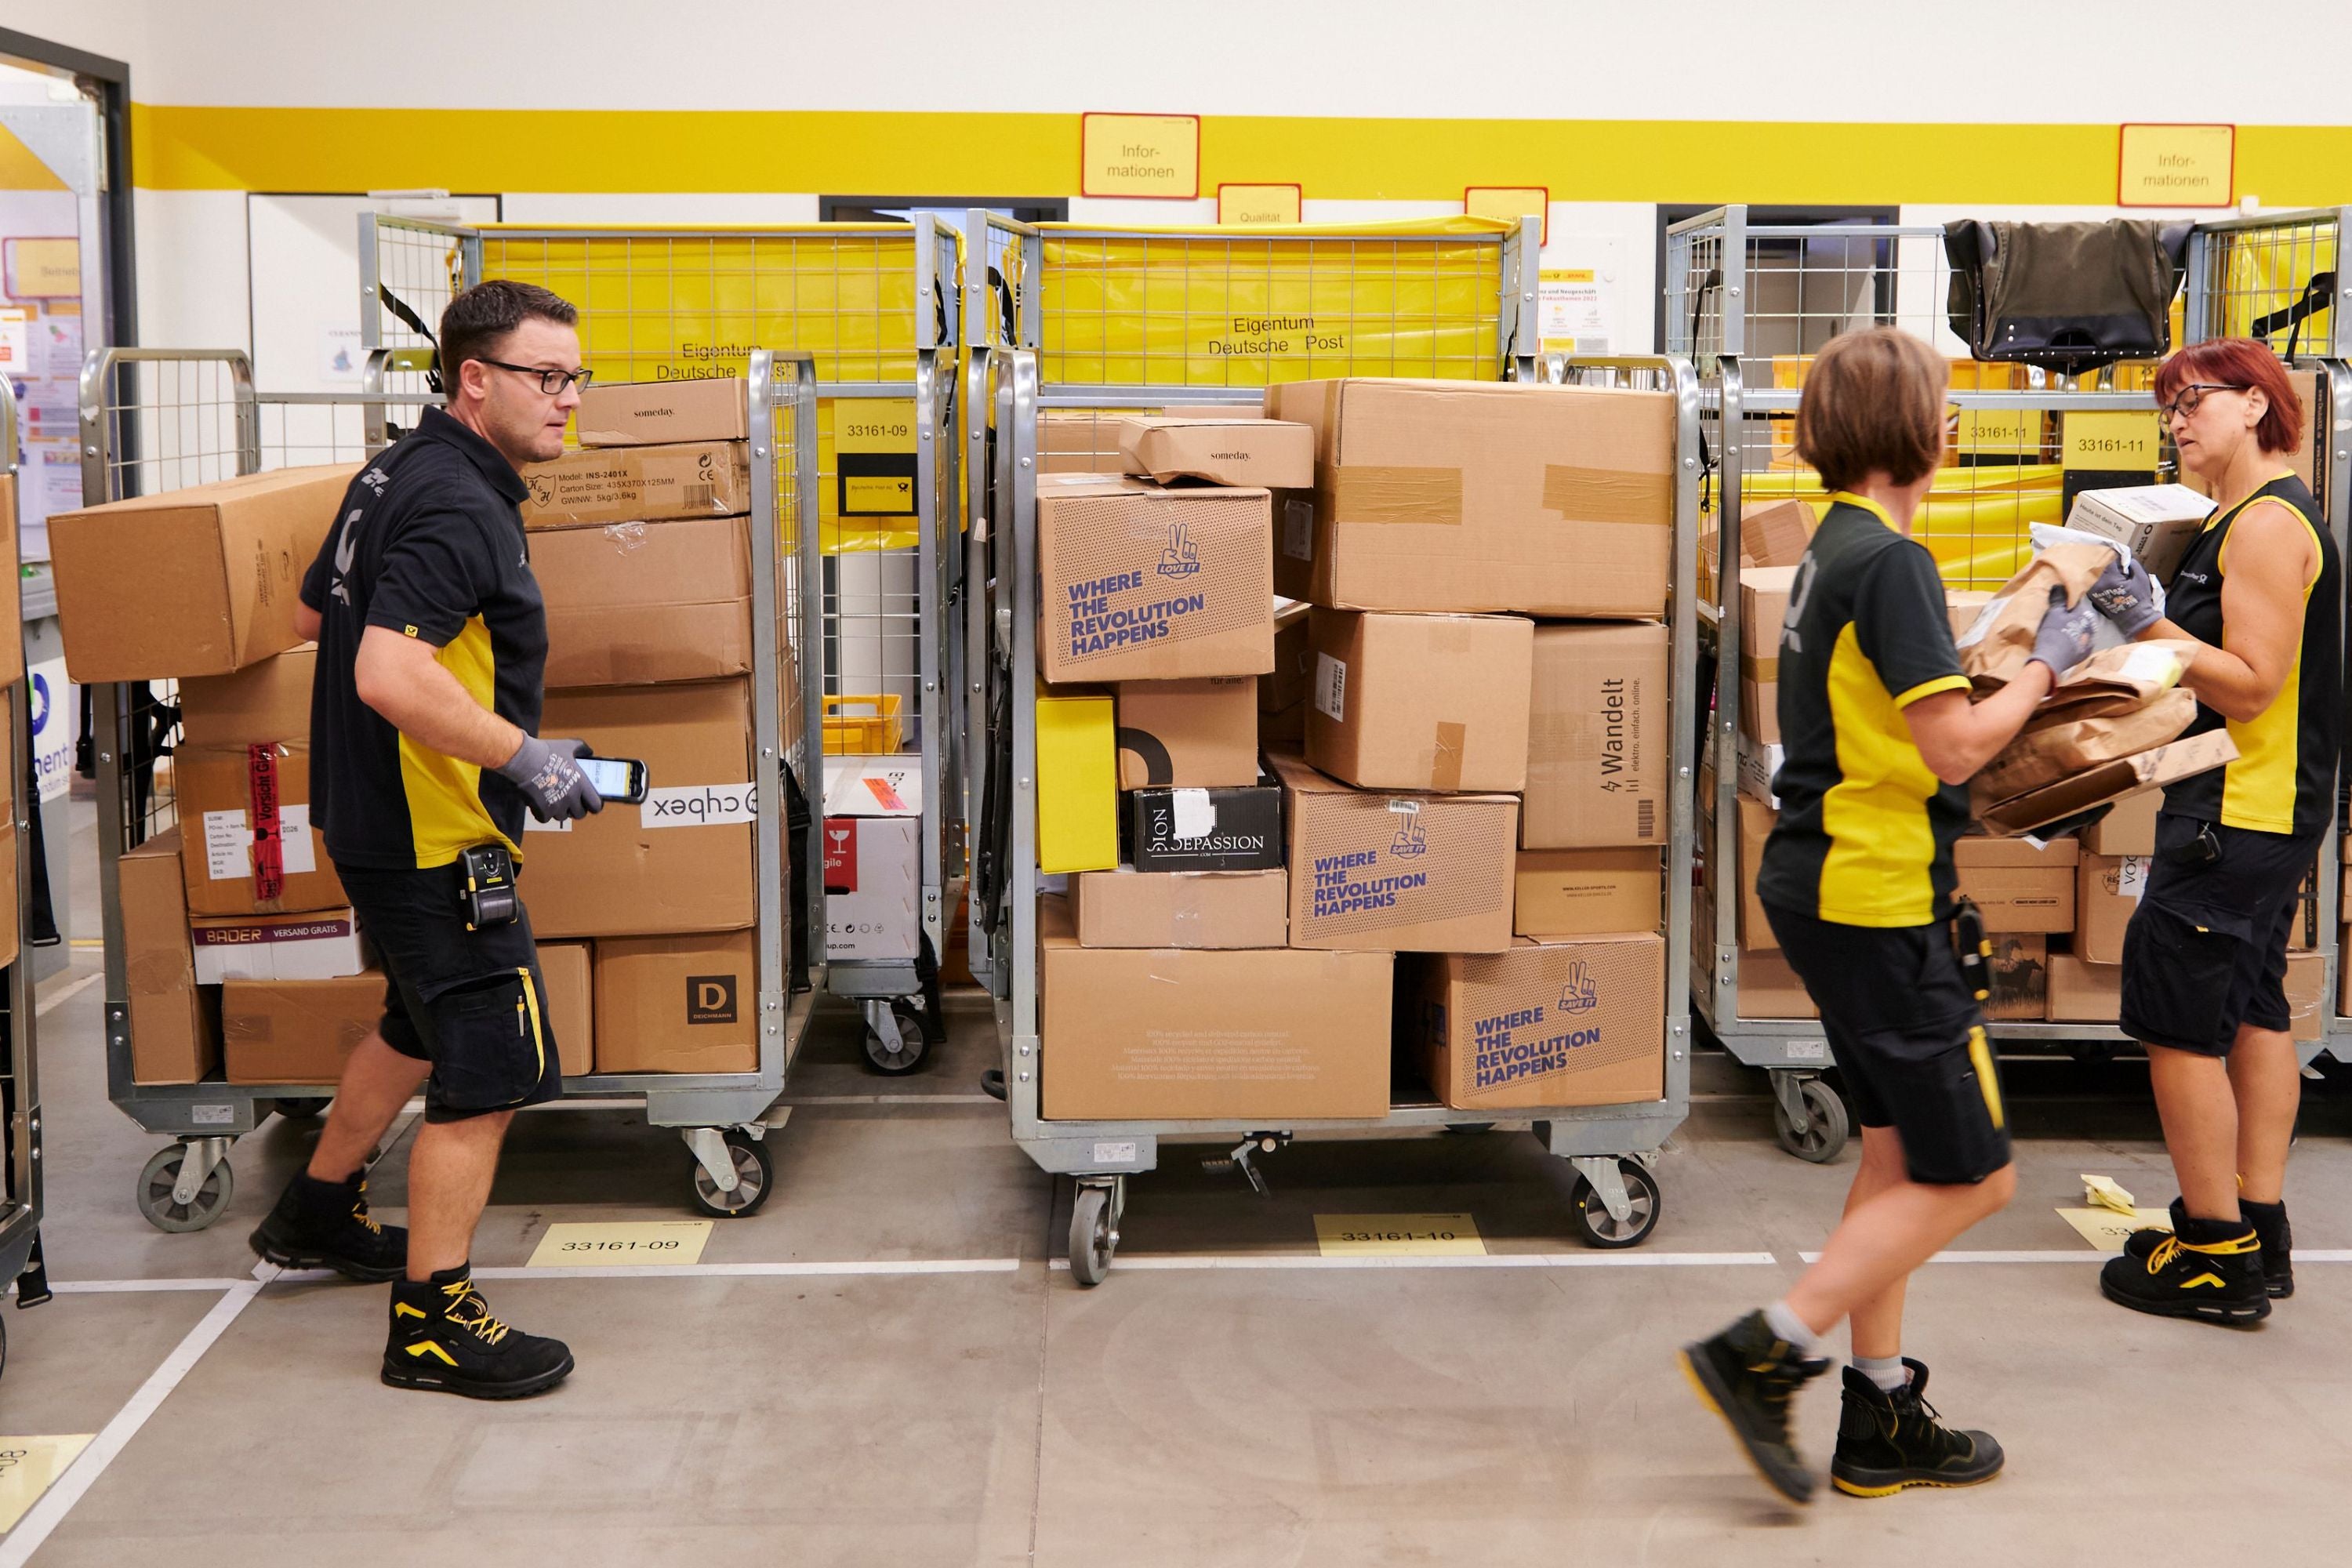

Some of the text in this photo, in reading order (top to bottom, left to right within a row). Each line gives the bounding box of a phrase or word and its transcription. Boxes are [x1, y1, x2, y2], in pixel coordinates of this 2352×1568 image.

[1122, 144, 1161, 158] Infor-
[2158, 154, 2196, 167] Infor-
[1107, 164, 1175, 178] mationen
[2143, 174, 2210, 187] mationen
[1240, 212, 1281, 223] Qualität
[1234, 316, 1315, 336] Eigentum
[1209, 334, 1345, 355] Deutsche Post
[657, 363, 736, 380] Deutsche
[633, 405, 675, 419] someday.
[848, 425, 908, 437] 33161-09
[1970, 426, 2027, 439] 33161-11
[2078, 439, 2144, 452] 33161-11
[1210, 450, 1251, 462] someday.
[558, 470, 628, 482] Model: INS-2401X
[560, 477, 675, 494] Carton Size: 435X370X125MM
[561, 492, 637, 506] GW/NW: 5kg/3.6kg
[1160, 563, 1199, 573] LOVE IT
[1068, 571, 1143, 601] WHERE
[1069, 597, 1109, 619] THE
[1071, 593, 1204, 638] REVOLUTION
[1072, 619, 1170, 656] HAPPENS
[1600, 678, 1624, 775] Wandelt
[1631, 677, 1640, 772] elektro. einfach. online.
[256, 775, 272, 821] Vorsicht
[653, 788, 739, 822] cybex
[1392, 844, 1425, 854] SAVE IT
[1315, 851, 1377, 873] WHERE
[1314, 870, 1347, 887] THE
[1315, 873, 1427, 902] REVOLUTION
[1314, 892, 1396, 917] HAPPENS
[206, 925, 338, 943] BADER VERSAND GRATIS
[699, 983, 728, 1011] D
[1560, 998, 1595, 1009] SAVE IT
[1475, 1006, 1544, 1036] WHERE
[1475, 1031, 1512, 1053] THE
[1476, 1027, 1600, 1071] REVOLUTION
[1476, 1052, 1567, 1087] HAPPENS
[561, 1240, 681, 1251] 33161-09
[1341, 1232, 1455, 1242] 33161-10
